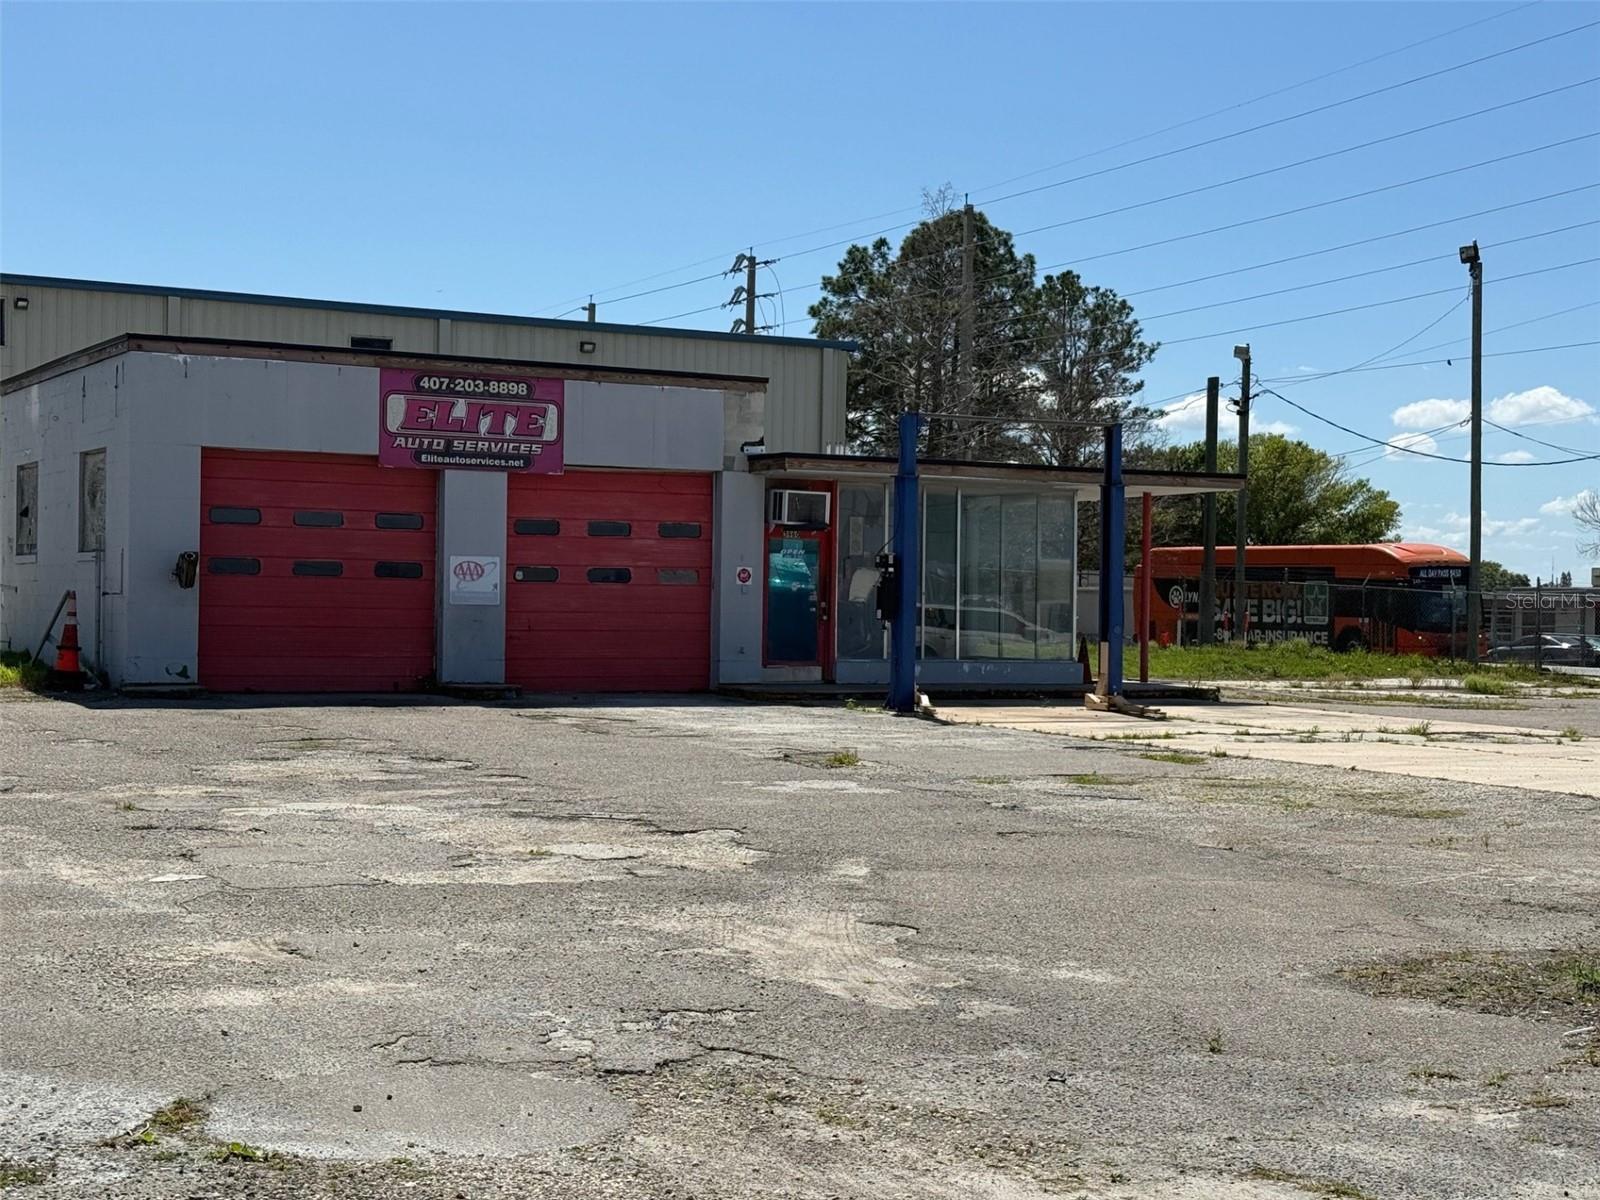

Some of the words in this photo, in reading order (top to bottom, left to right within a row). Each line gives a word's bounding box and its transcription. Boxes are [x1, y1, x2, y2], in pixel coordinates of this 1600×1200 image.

[420, 377, 527, 395] 407-203-8898
[401, 399, 548, 437] ELITE
[393, 437, 444, 449] AUTO
[453, 441, 543, 455] SERVICES
[421, 454, 524, 467] Eliteautoservices.net
[457, 562, 481, 578] AAA
[1262, 600, 1302, 624] BIG!
